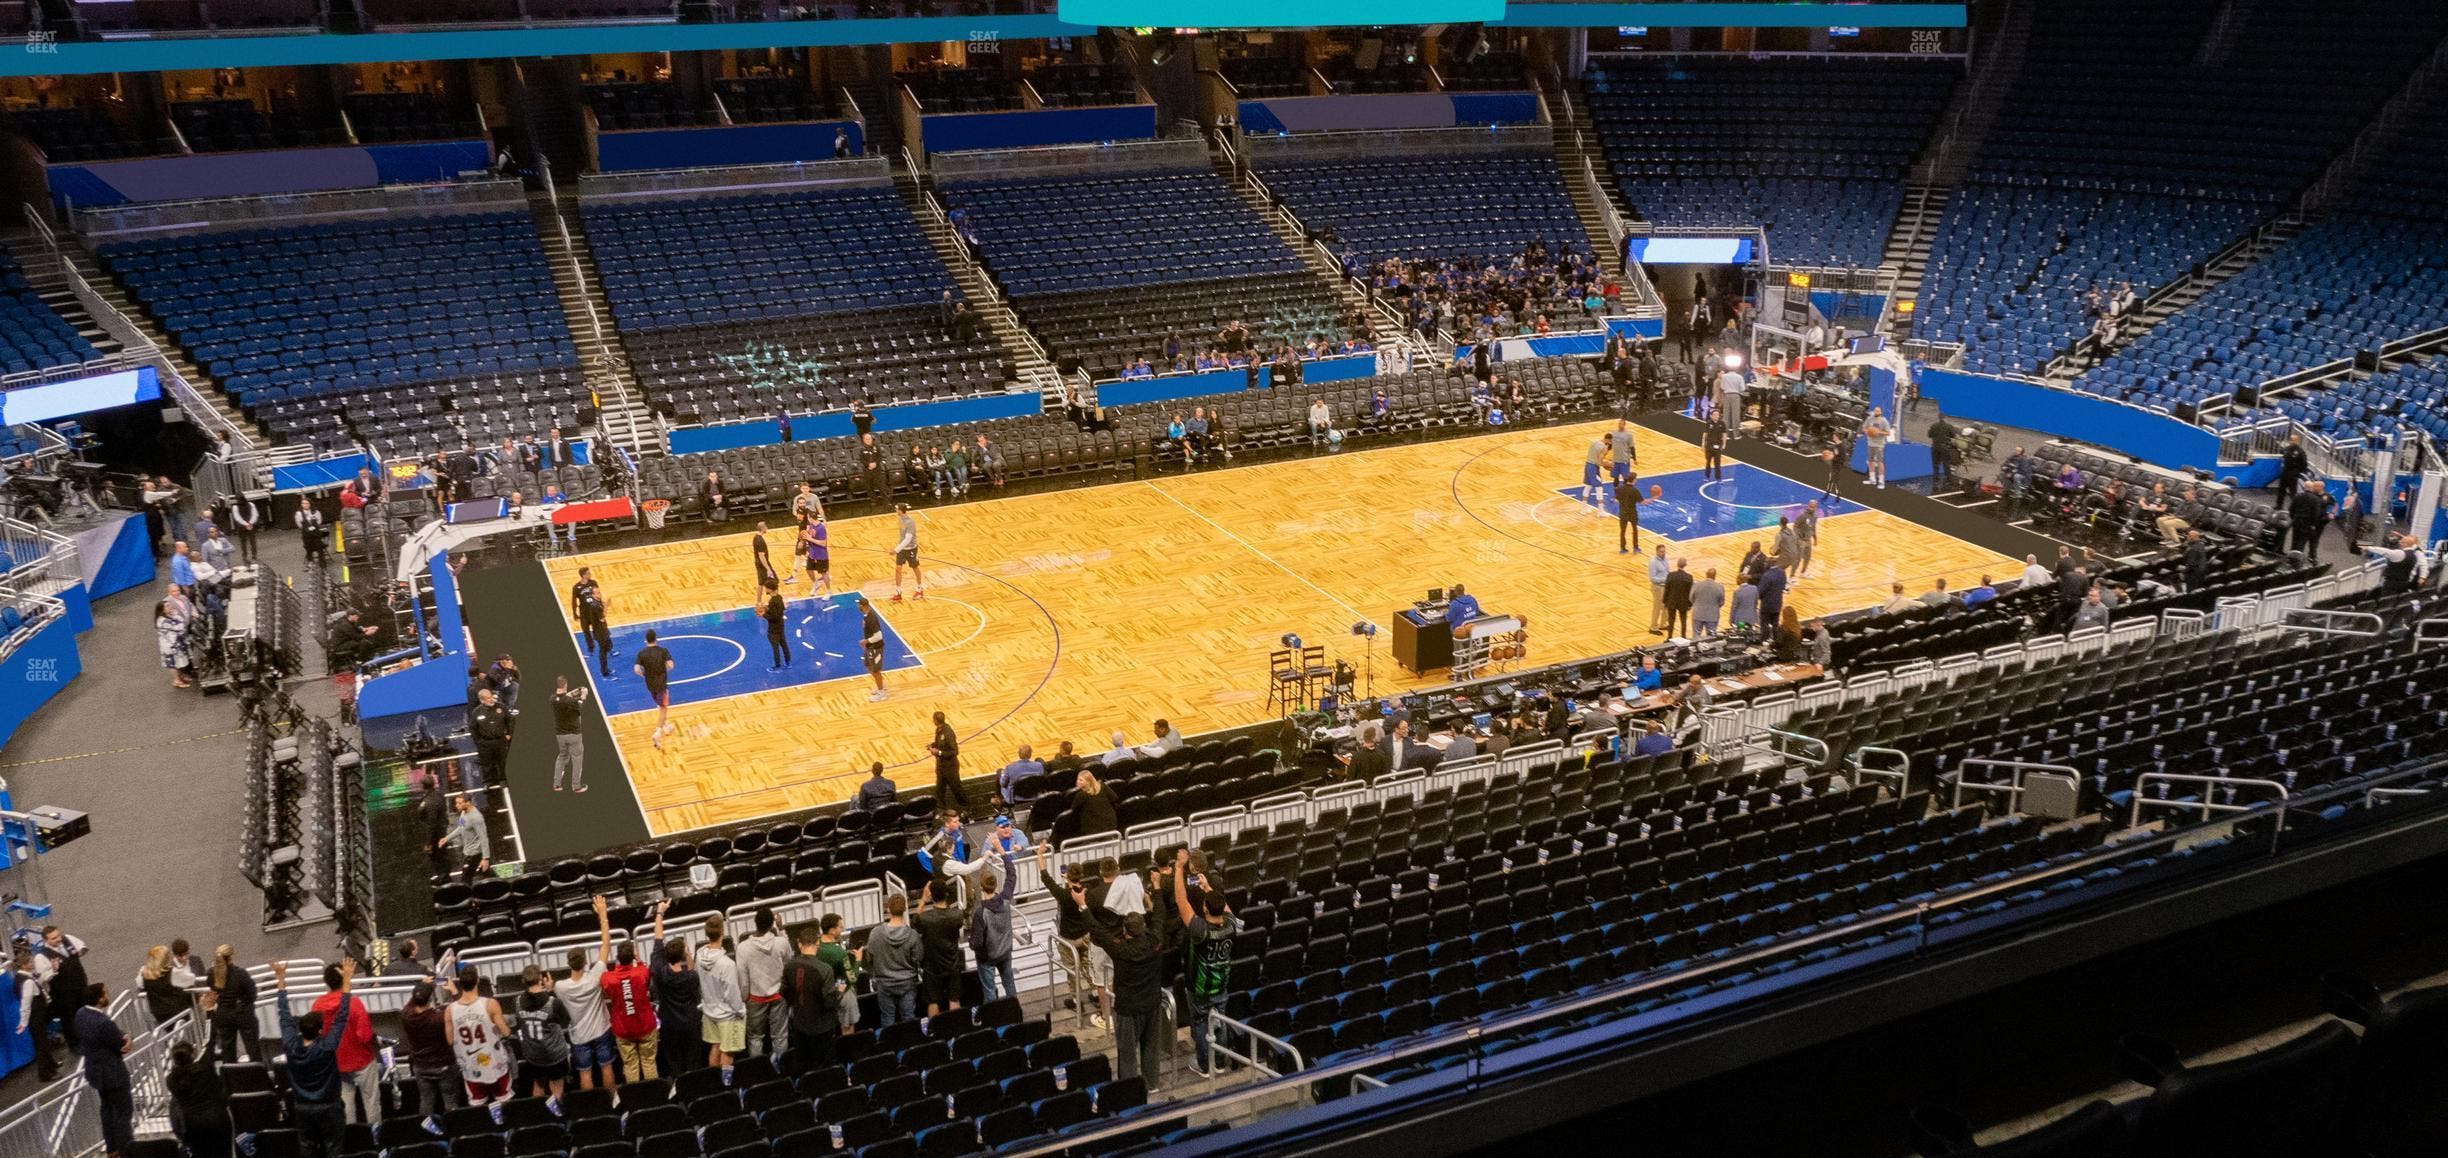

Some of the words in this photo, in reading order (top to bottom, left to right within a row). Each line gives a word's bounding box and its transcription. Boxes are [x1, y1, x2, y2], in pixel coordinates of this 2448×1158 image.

[621, 979, 633, 1000] NIKE
[625, 1000, 636, 1016] AIR
[458, 1023, 487, 1046] 94
[525, 1020, 543, 1040] 11
